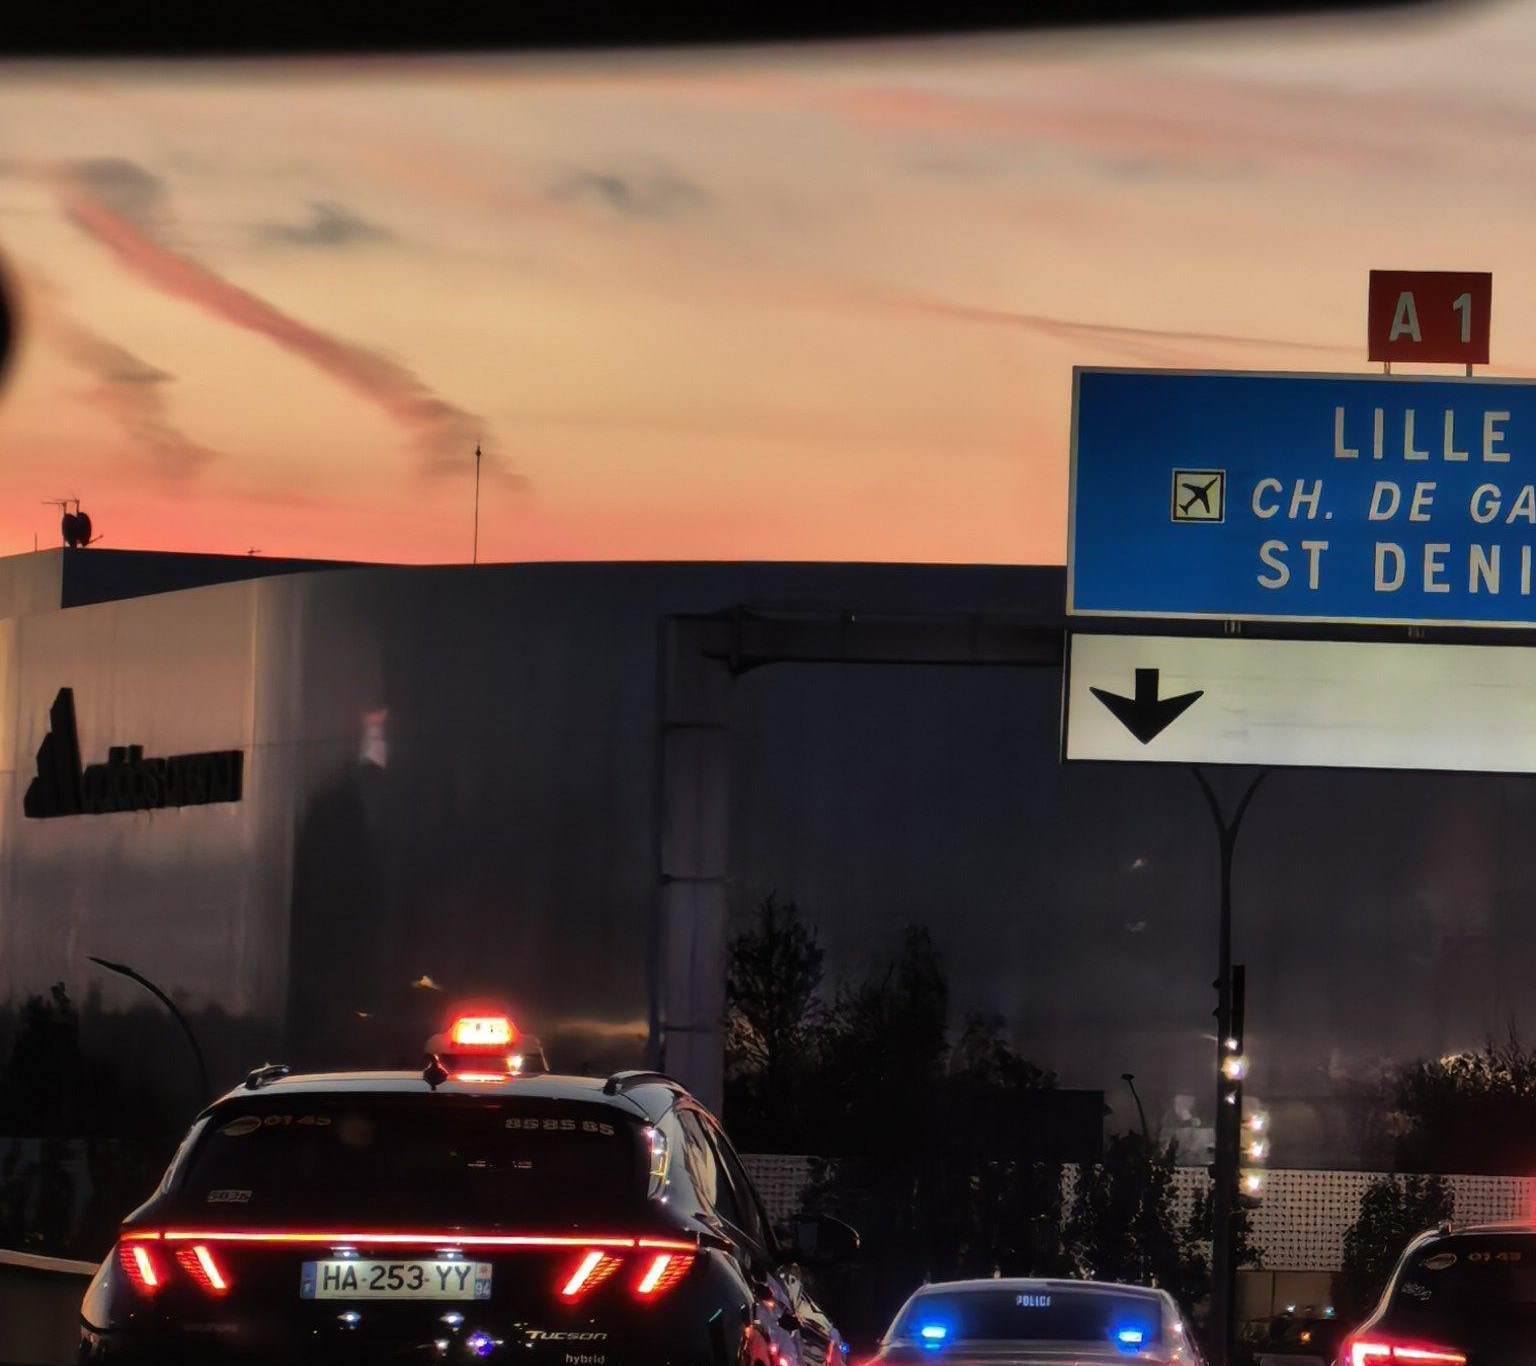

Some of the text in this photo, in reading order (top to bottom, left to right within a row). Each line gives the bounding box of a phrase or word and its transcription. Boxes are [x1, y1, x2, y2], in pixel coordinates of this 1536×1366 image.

[1388, 291, 1473, 344] A 1
[1333, 406, 1511, 463] LILLE
[1251, 477, 1334, 522] CH.
[1367, 481, 1438, 524] DE
[1257, 539, 1329, 591] ST
[565, 1353, 606, 1366] hybrid
